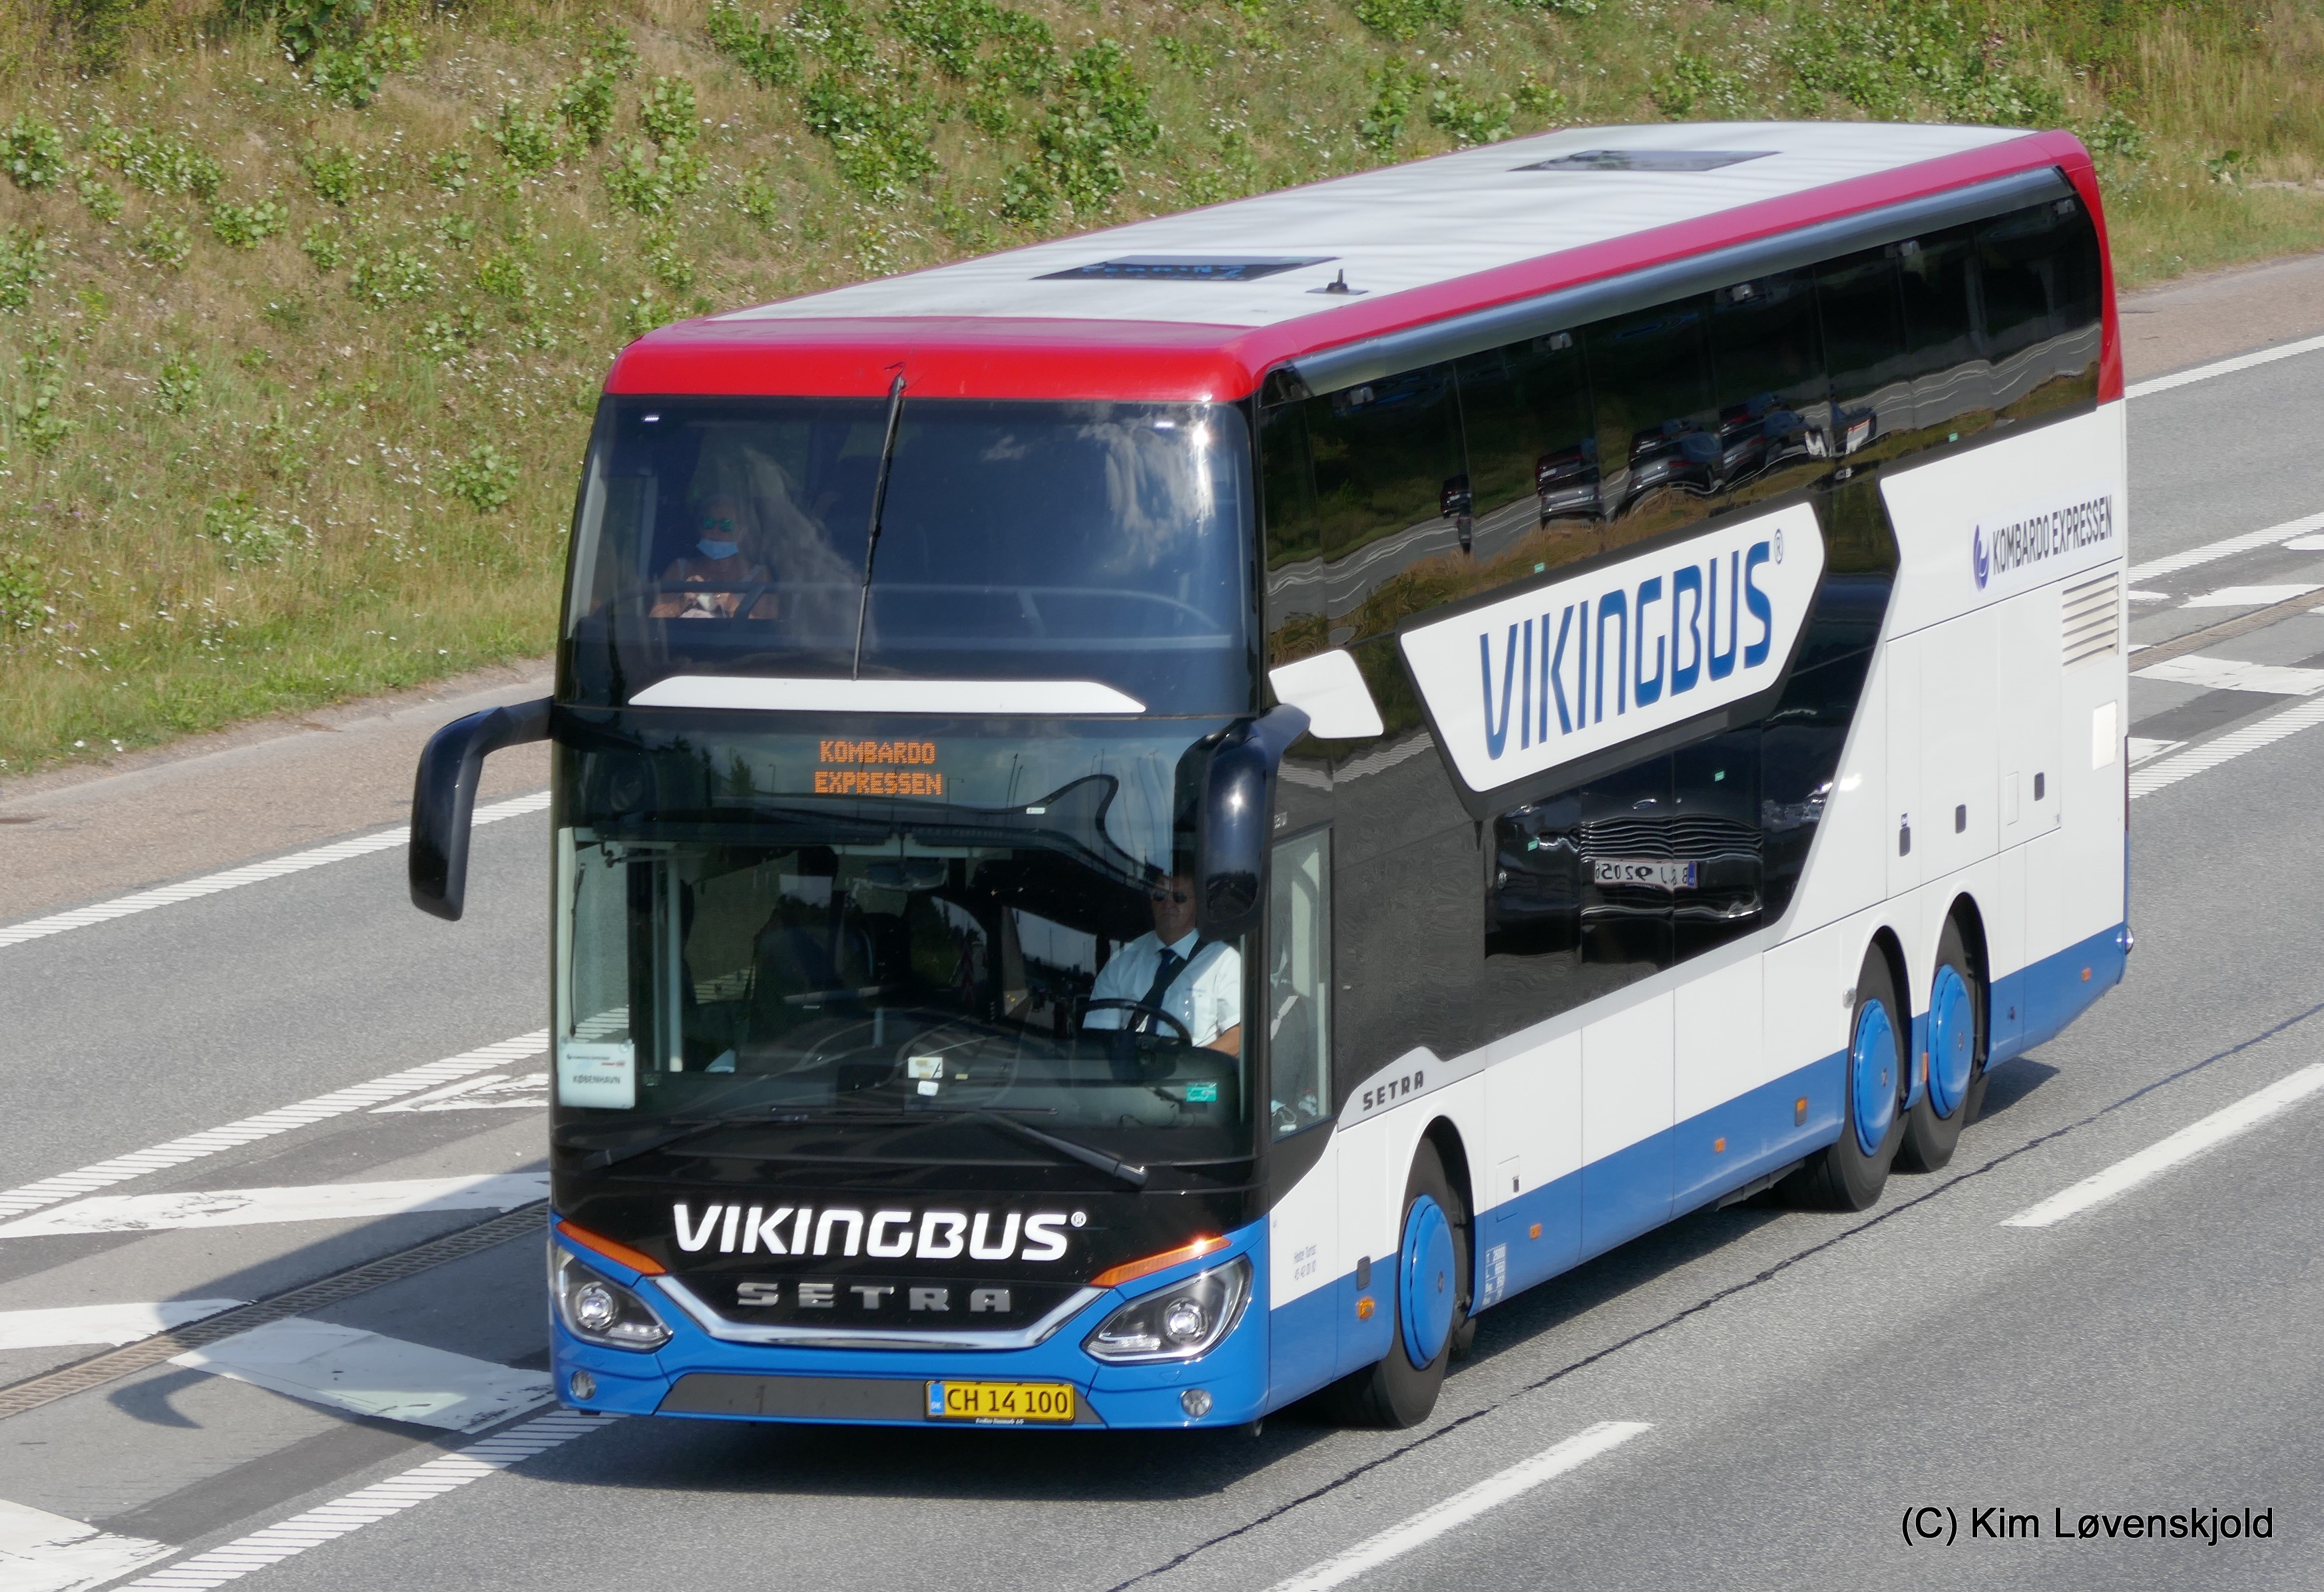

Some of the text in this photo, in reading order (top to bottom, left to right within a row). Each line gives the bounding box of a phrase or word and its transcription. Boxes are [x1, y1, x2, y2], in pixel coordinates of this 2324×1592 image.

[1993, 495, 2112, 575] KOMBARDO EXPRESSEN
[819, 740, 936, 764] KOMBARDO
[814, 771, 943, 795] EXPRESSEN
[1363, 1070, 1424, 1111] SETRA
[737, 1283, 1011, 1312] SETRA
[947, 1388, 979, 1411] CH
[989, 1390, 1015, 1412] 14
[1025, 1391, 1068, 1414] 100
